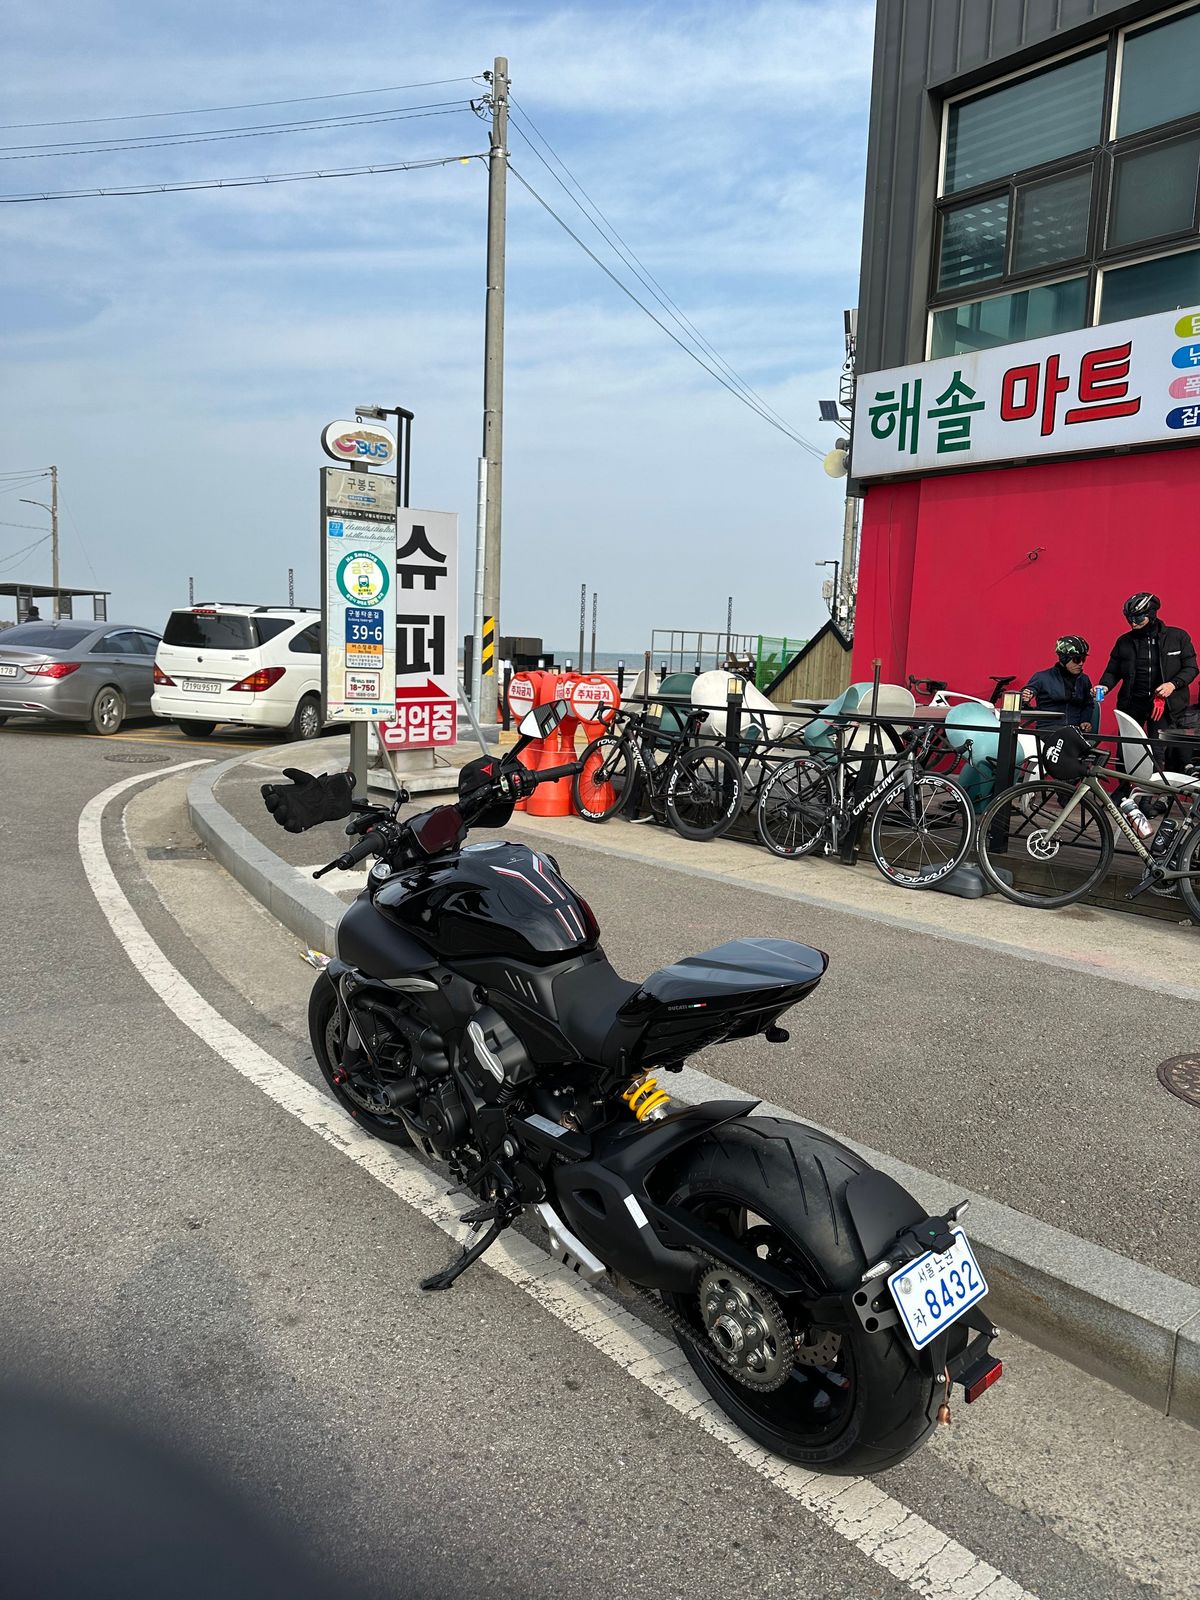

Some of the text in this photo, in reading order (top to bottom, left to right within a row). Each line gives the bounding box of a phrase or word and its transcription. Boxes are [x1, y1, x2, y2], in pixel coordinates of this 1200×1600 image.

[868, 340, 1142, 455] 해솔 마트
[347, 477, 376, 492] 구봉도
[352, 625, 383, 641] 39-6
[350, 684, 376, 692] 18-750
[511, 685, 532, 697] 주차금지
[577, 689, 610, 700] 주차금지
[384, 704, 453, 744] 영업중
[1106, 801, 1149, 859] cannondale
[894, 857, 955, 884] DURA-ACE
[918, 1262, 935, 1283] 서울
[924, 1260, 979, 1320] 8432
